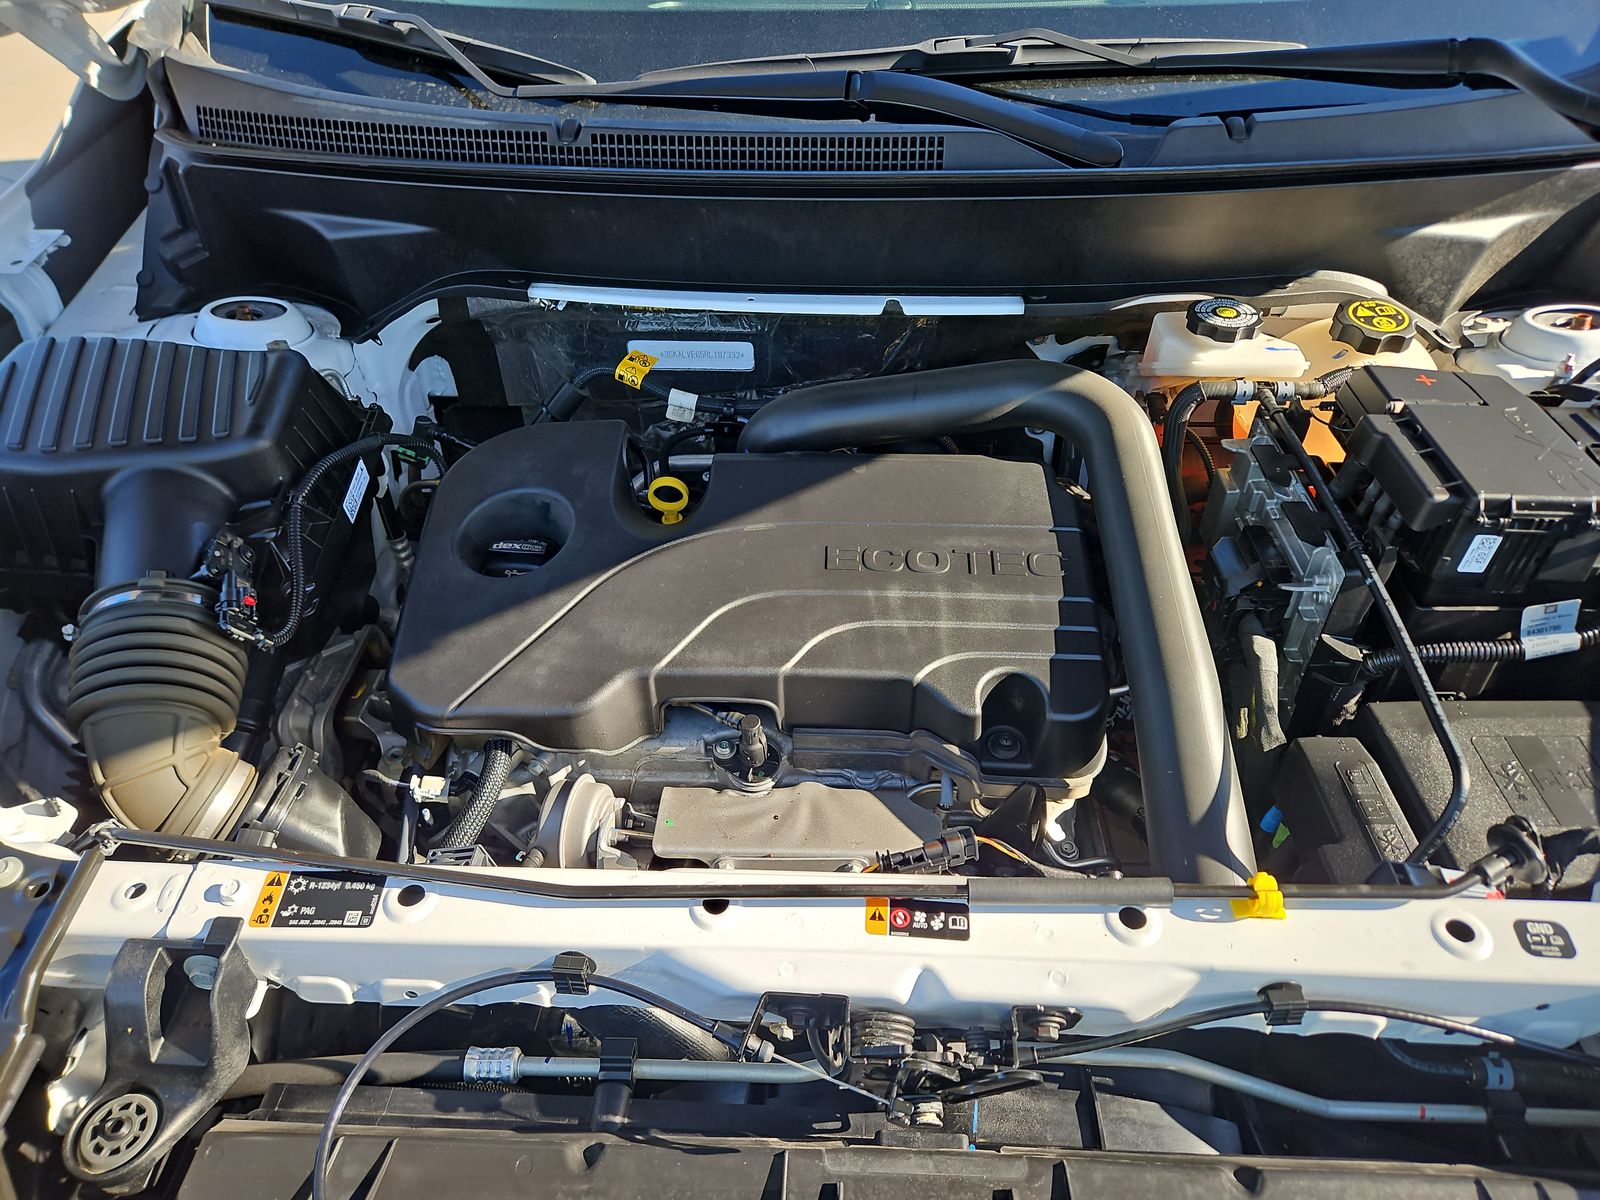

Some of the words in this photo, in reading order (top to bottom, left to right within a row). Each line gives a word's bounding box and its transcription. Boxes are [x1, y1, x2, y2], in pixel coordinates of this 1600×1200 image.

[492, 541, 542, 552] dexos
[824, 545, 1068, 578] ECOTEC
[308, 881, 341, 891] R-1234yf
[365, 882, 376, 891] kg
[300, 906, 316, 915] PAG
[912, 921, 928, 929] AUTO
